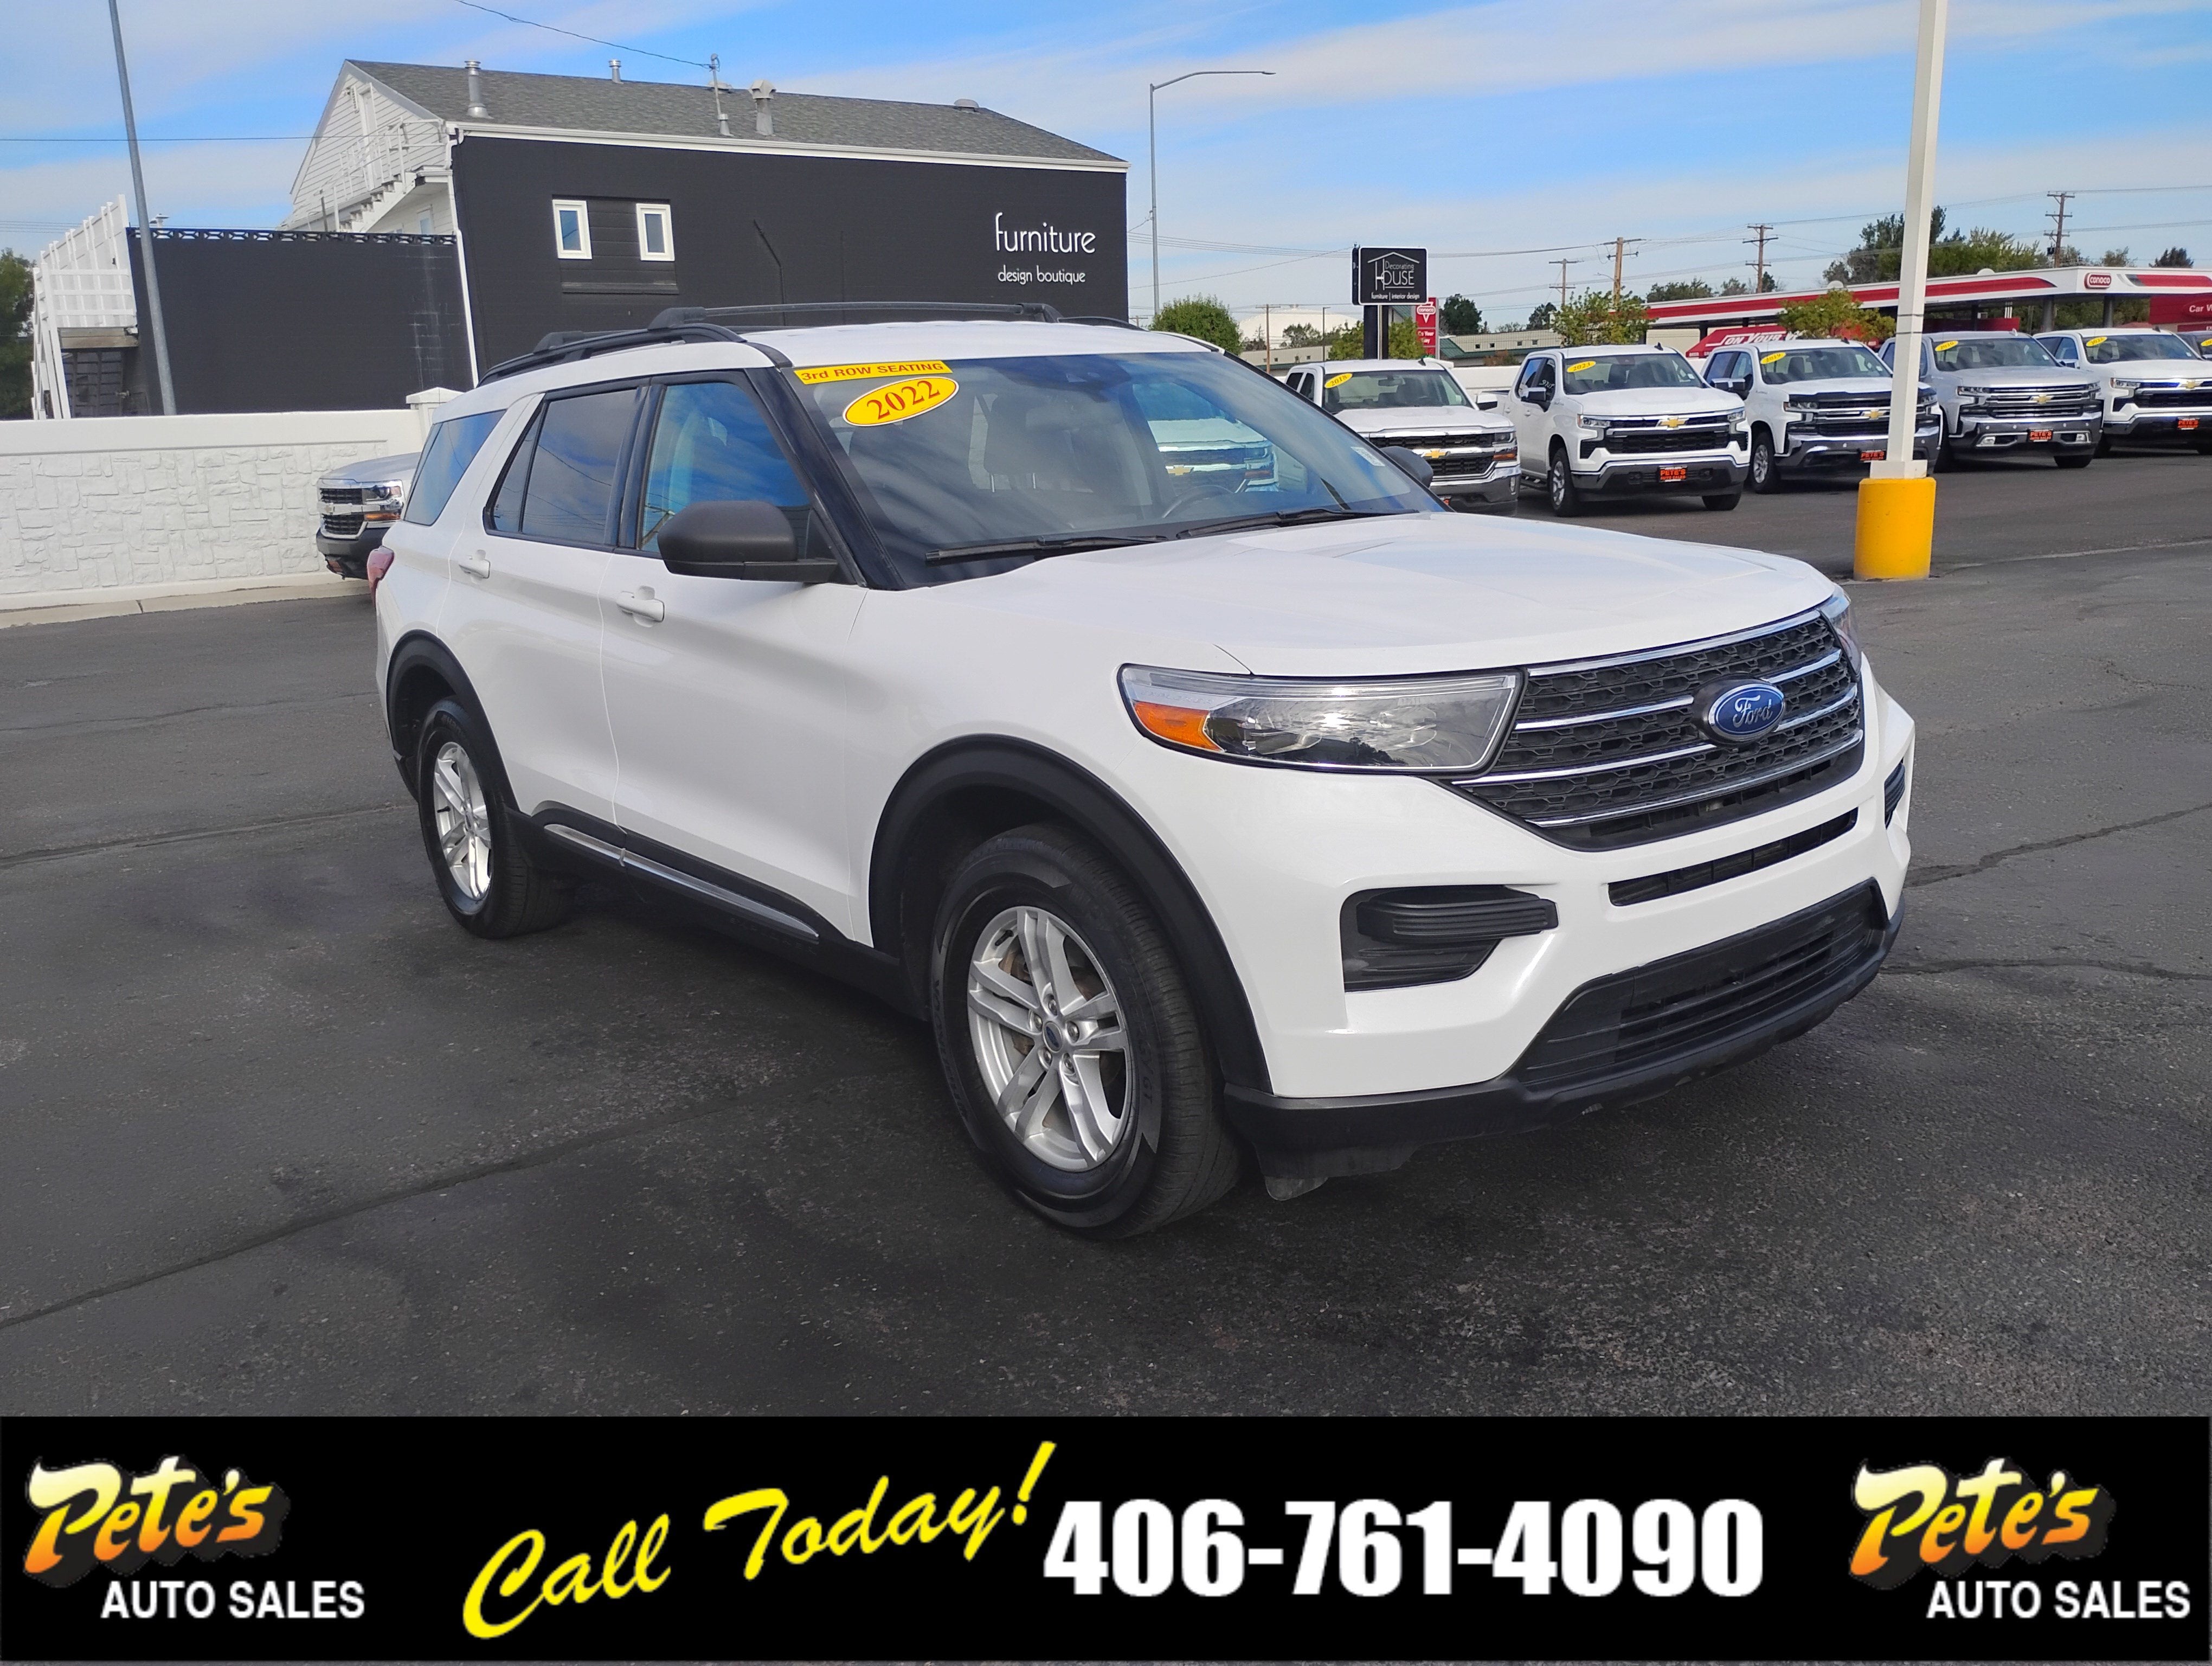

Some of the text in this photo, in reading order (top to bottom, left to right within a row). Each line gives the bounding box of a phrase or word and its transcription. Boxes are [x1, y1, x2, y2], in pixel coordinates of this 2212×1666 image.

[995, 212, 1096, 253] furniture
[998, 265, 1086, 285] design boutique
[1375, 258, 1414, 291] HOUSE
[1385, 260, 1414, 271] Decorating
[2189, 305, 2204, 313] Car
[801, 363, 944, 381] 3rd ROW SEATING
[1330, 375, 1348, 387] 2018
[866, 380, 941, 420] 2022
[1733, 695, 1773, 728] Ford
